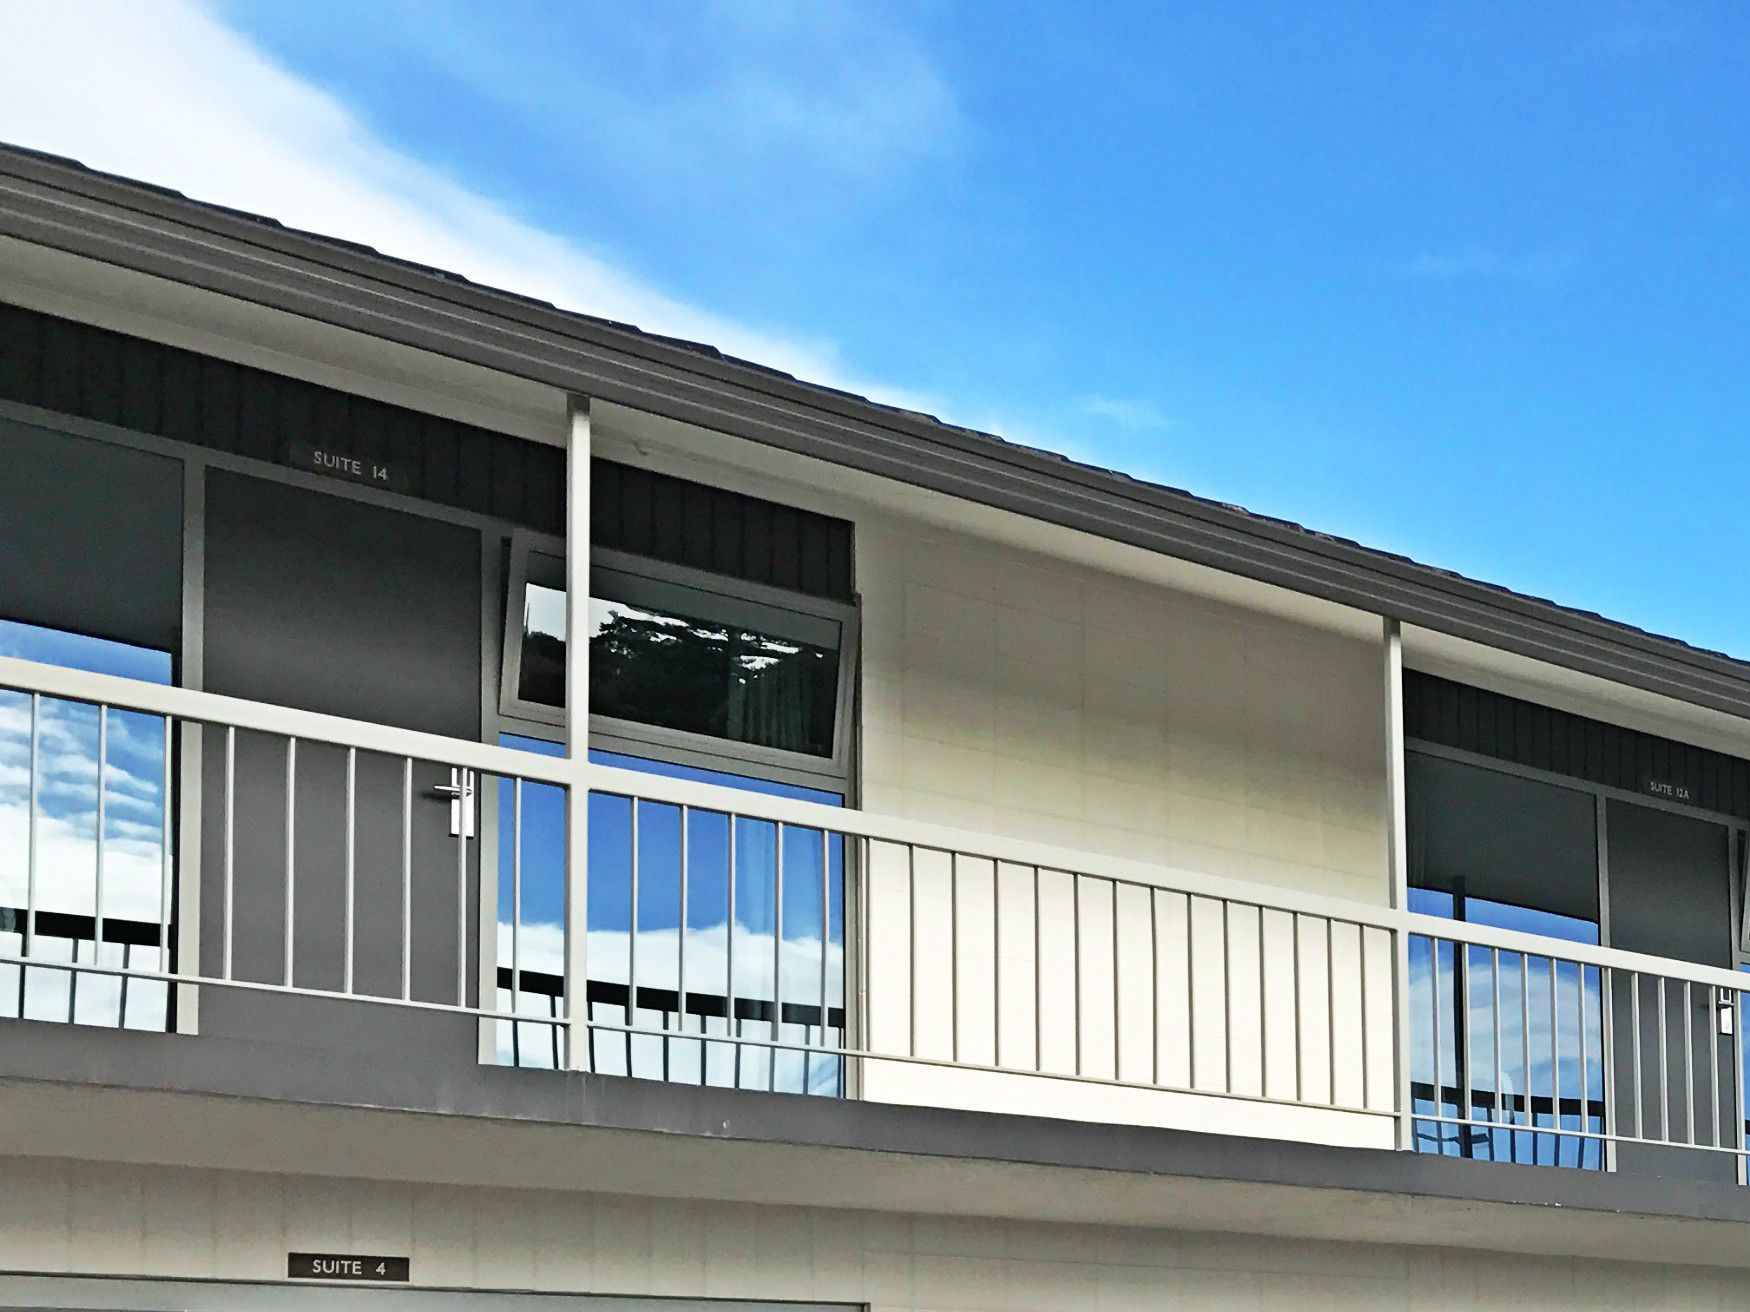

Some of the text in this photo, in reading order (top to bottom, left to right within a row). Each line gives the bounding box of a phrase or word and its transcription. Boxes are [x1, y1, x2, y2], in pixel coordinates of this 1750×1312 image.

[313, 451, 388, 481] SUITE 14
[1650, 781, 1672, 796] SUITE
[312, 1259, 386, 1276] SUITE 4
